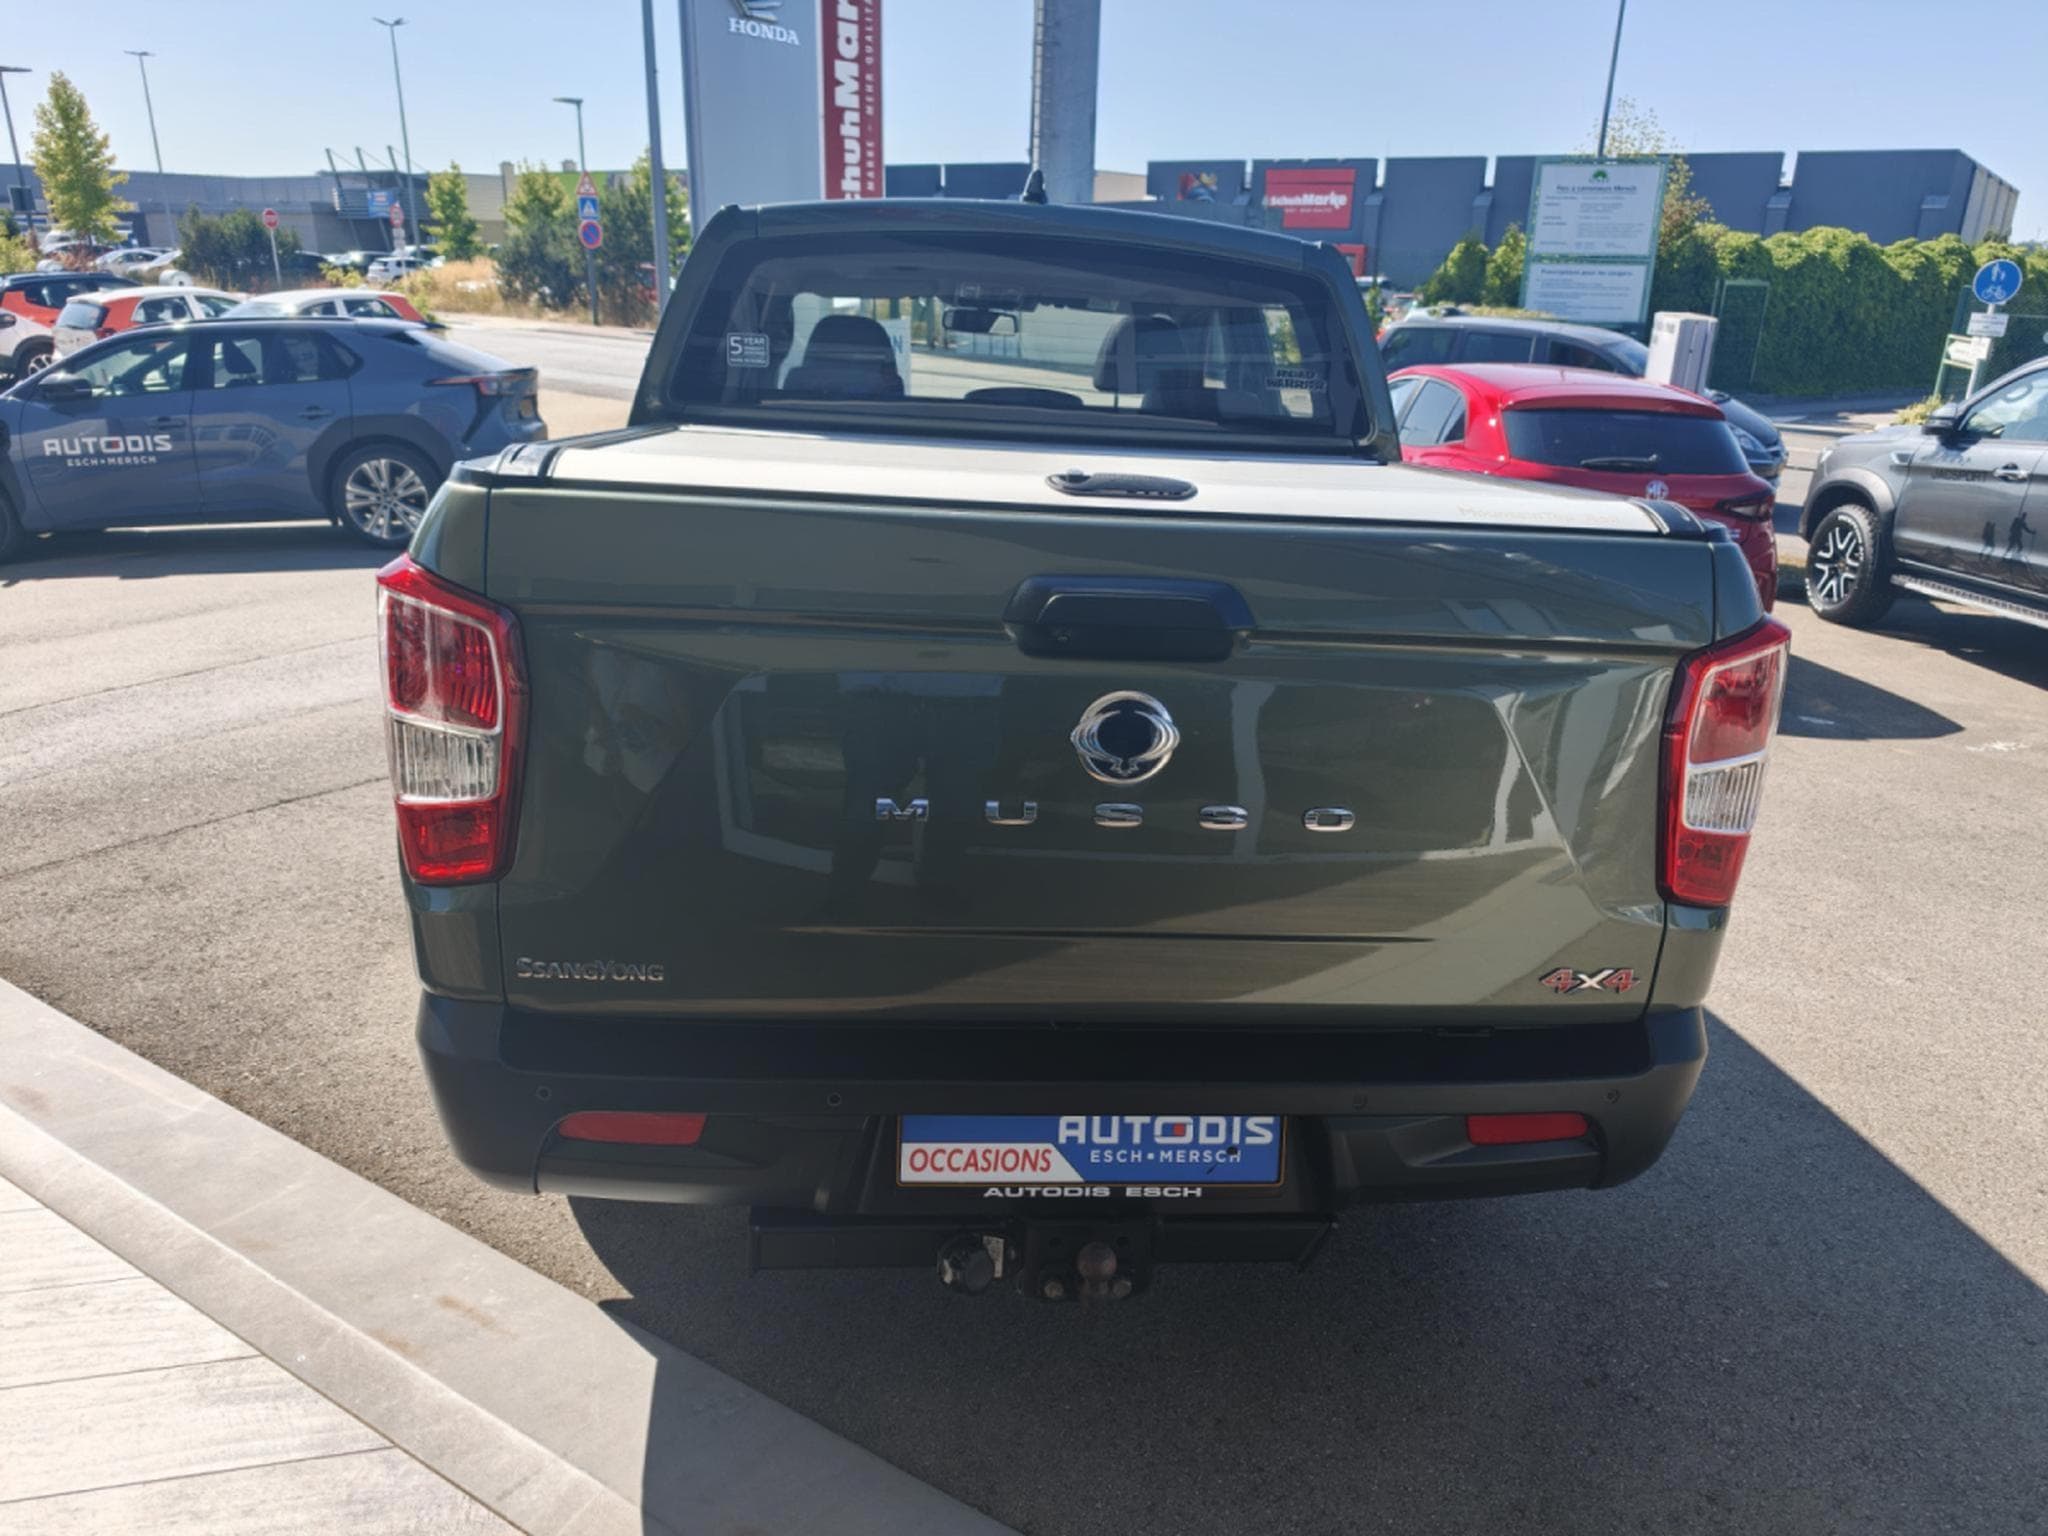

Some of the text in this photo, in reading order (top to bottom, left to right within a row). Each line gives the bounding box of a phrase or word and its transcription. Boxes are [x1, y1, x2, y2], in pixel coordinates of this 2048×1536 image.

[728, 17, 800, 46] HONDA
[730, 336, 743, 355] 5
[43, 434, 173, 456] AUTODIS
[876, 798, 1356, 832] MUSSO
[1057, 1115, 1275, 1145] AUTODIS
[909, 1148, 1053, 1174] OCCASIONS
[983, 1186, 1203, 1198] AUTODIS ESCH
